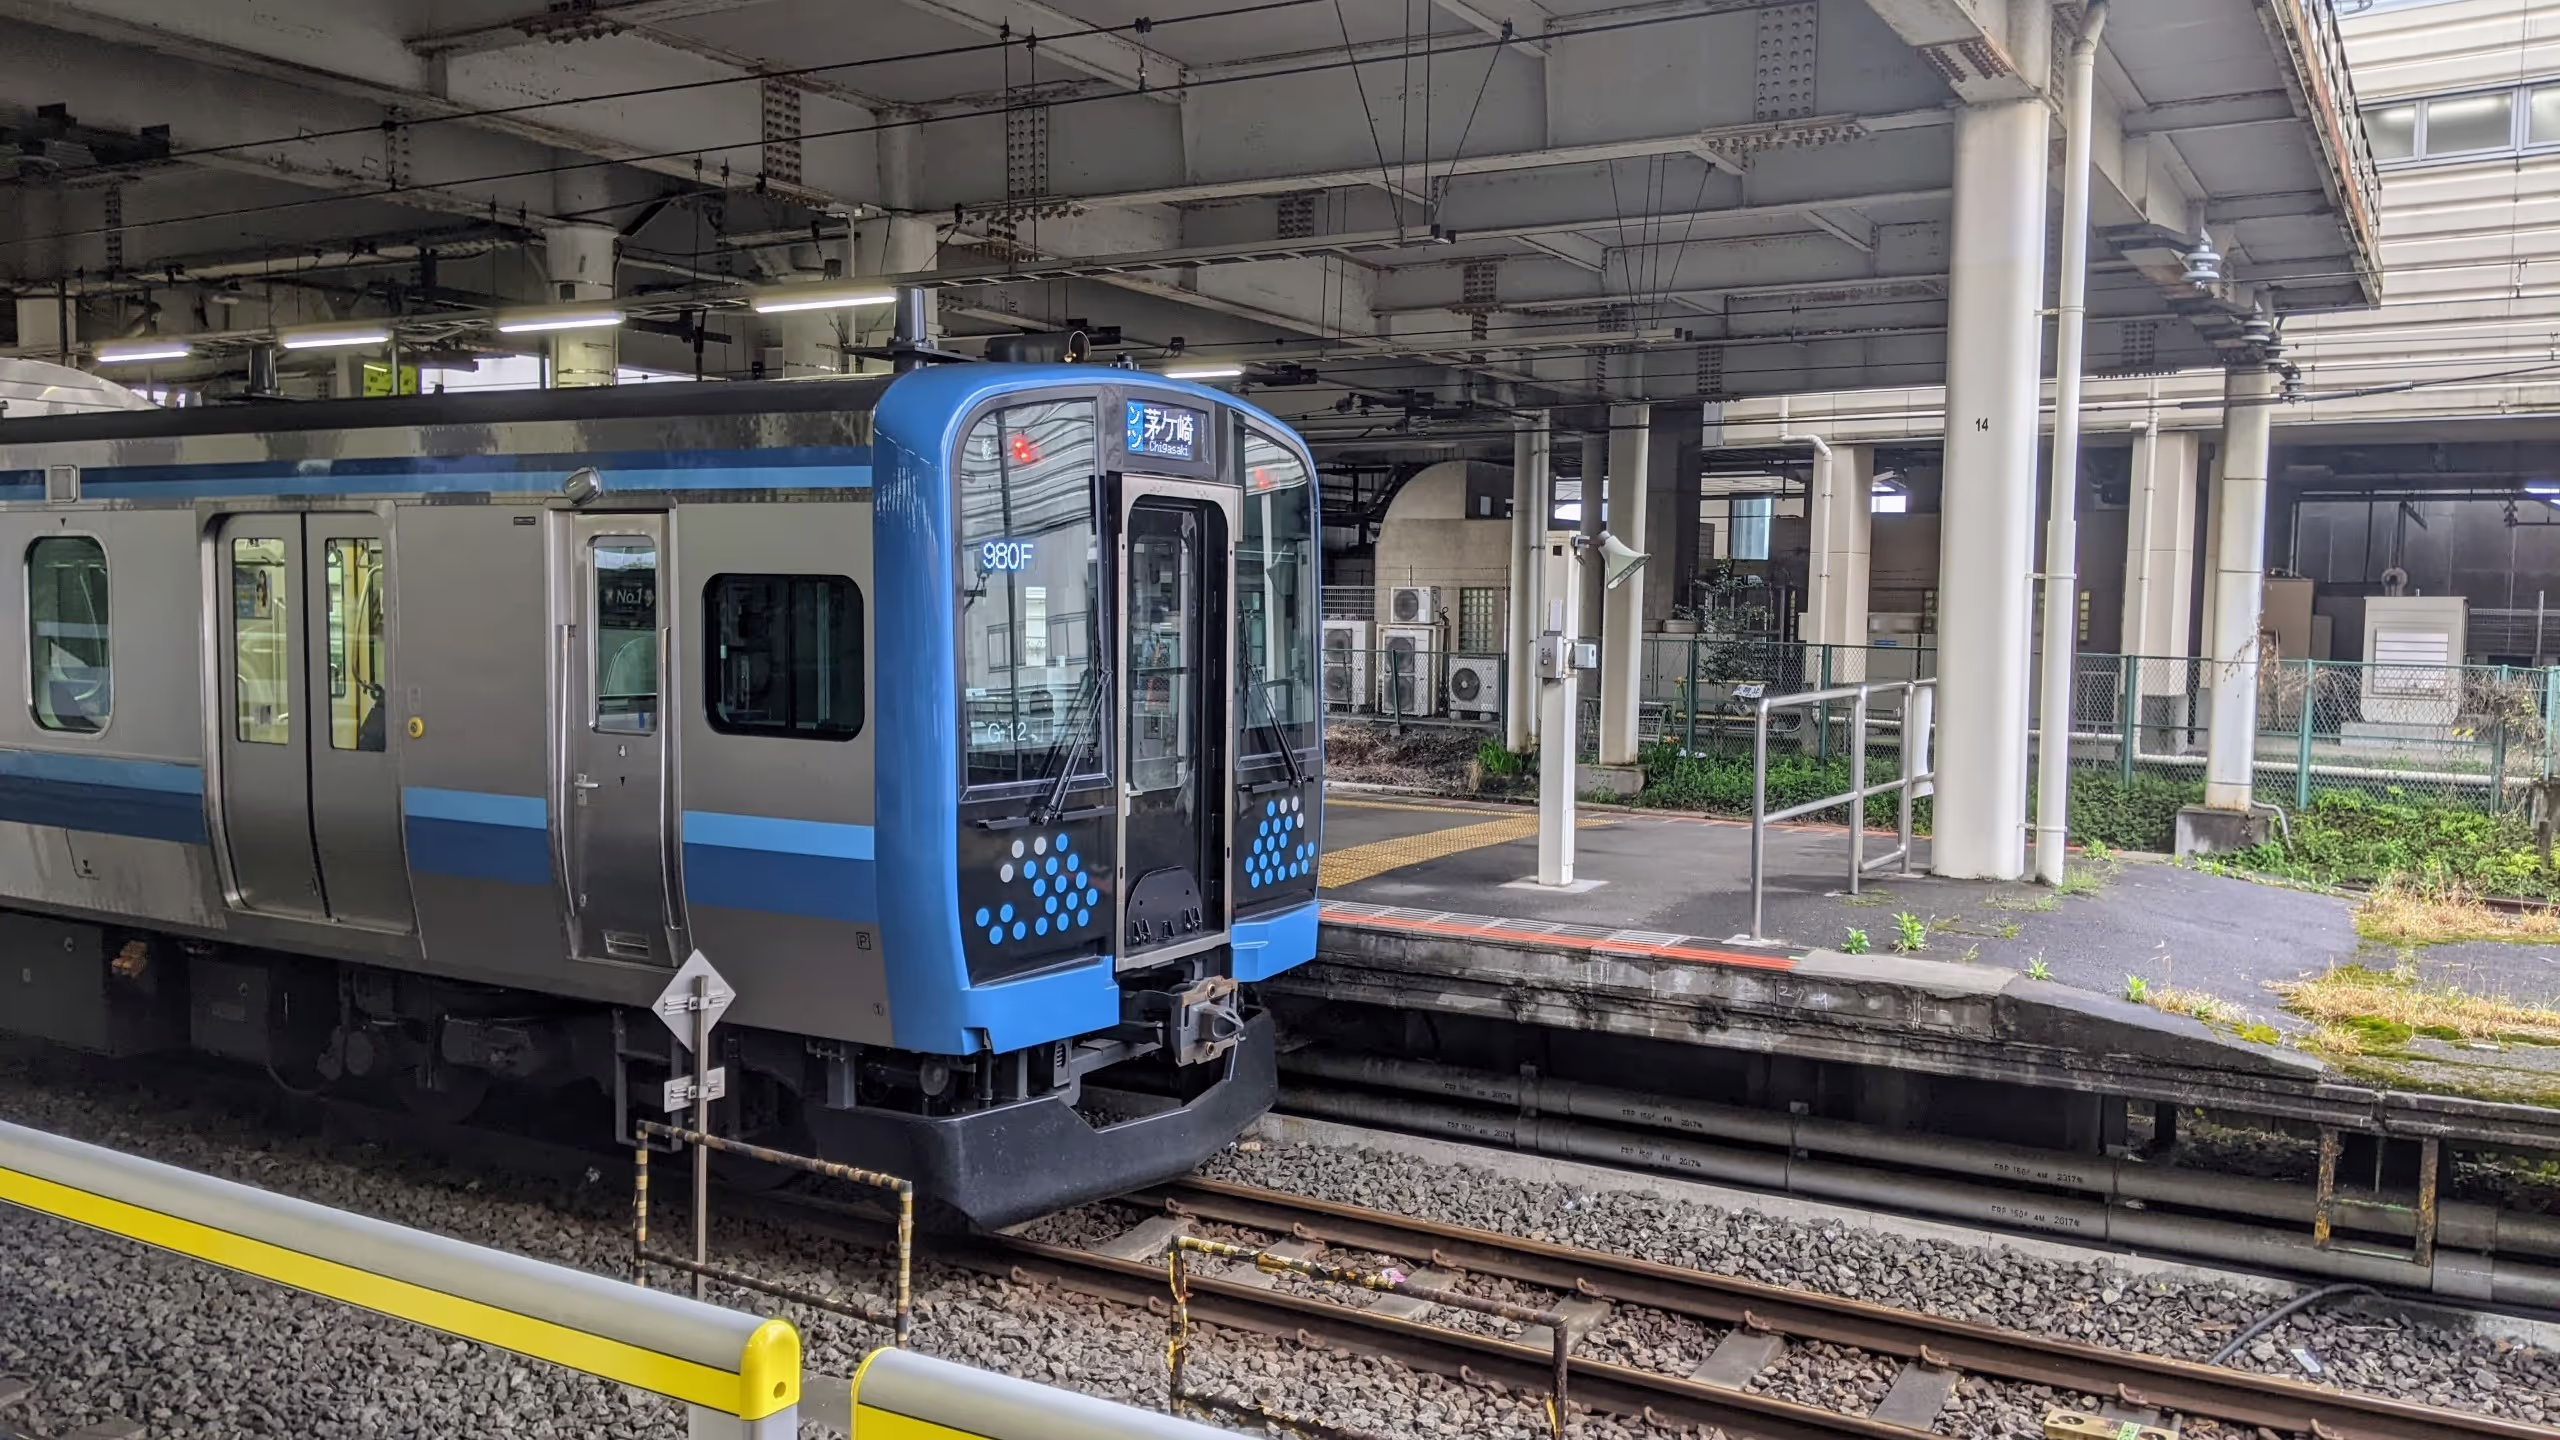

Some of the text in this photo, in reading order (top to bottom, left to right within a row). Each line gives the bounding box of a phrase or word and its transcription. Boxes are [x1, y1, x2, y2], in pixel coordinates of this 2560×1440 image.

[1144, 408, 1194, 446] 茅ケ崎
[1975, 417, 1989, 432] 14
[1149, 440, 1189, 456] Chigasaki
[983, 541, 1034, 570] 980F
